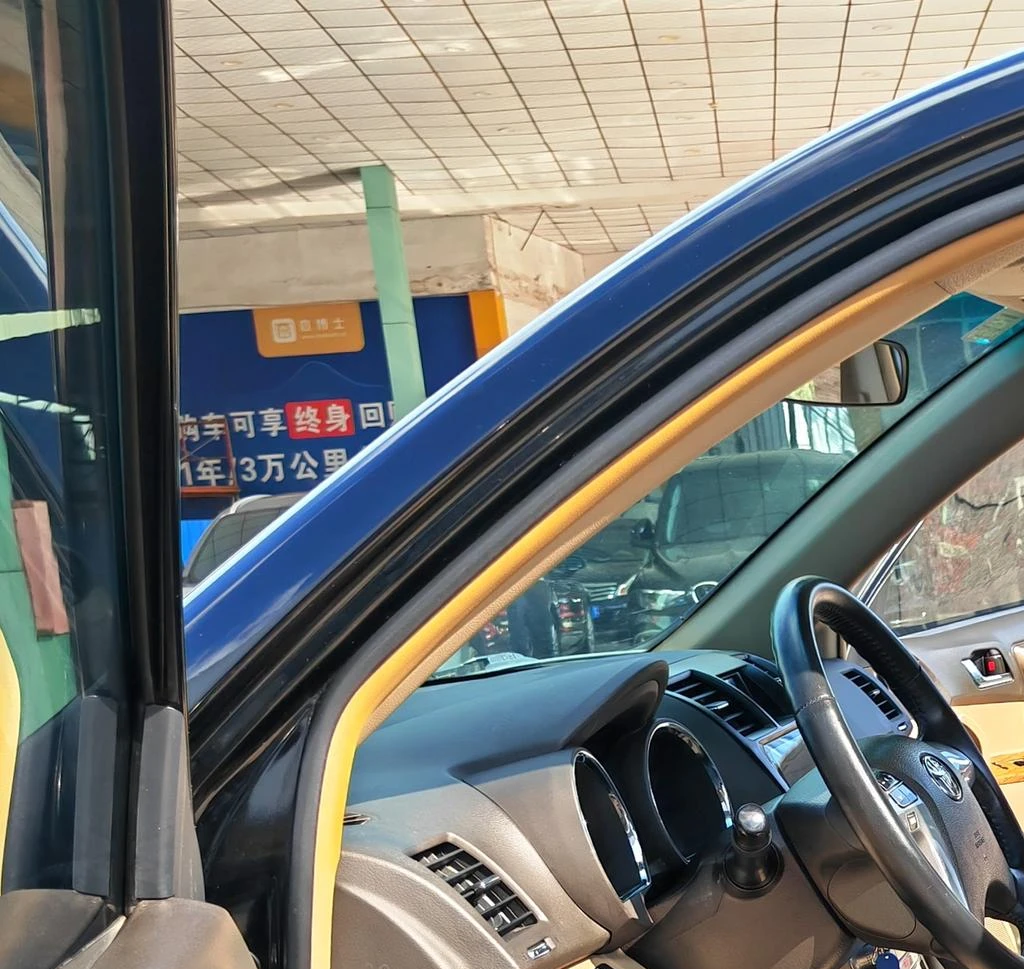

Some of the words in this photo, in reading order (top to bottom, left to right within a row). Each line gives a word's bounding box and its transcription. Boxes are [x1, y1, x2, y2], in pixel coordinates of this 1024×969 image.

[179, 401, 395, 442] 购车可享终身回
